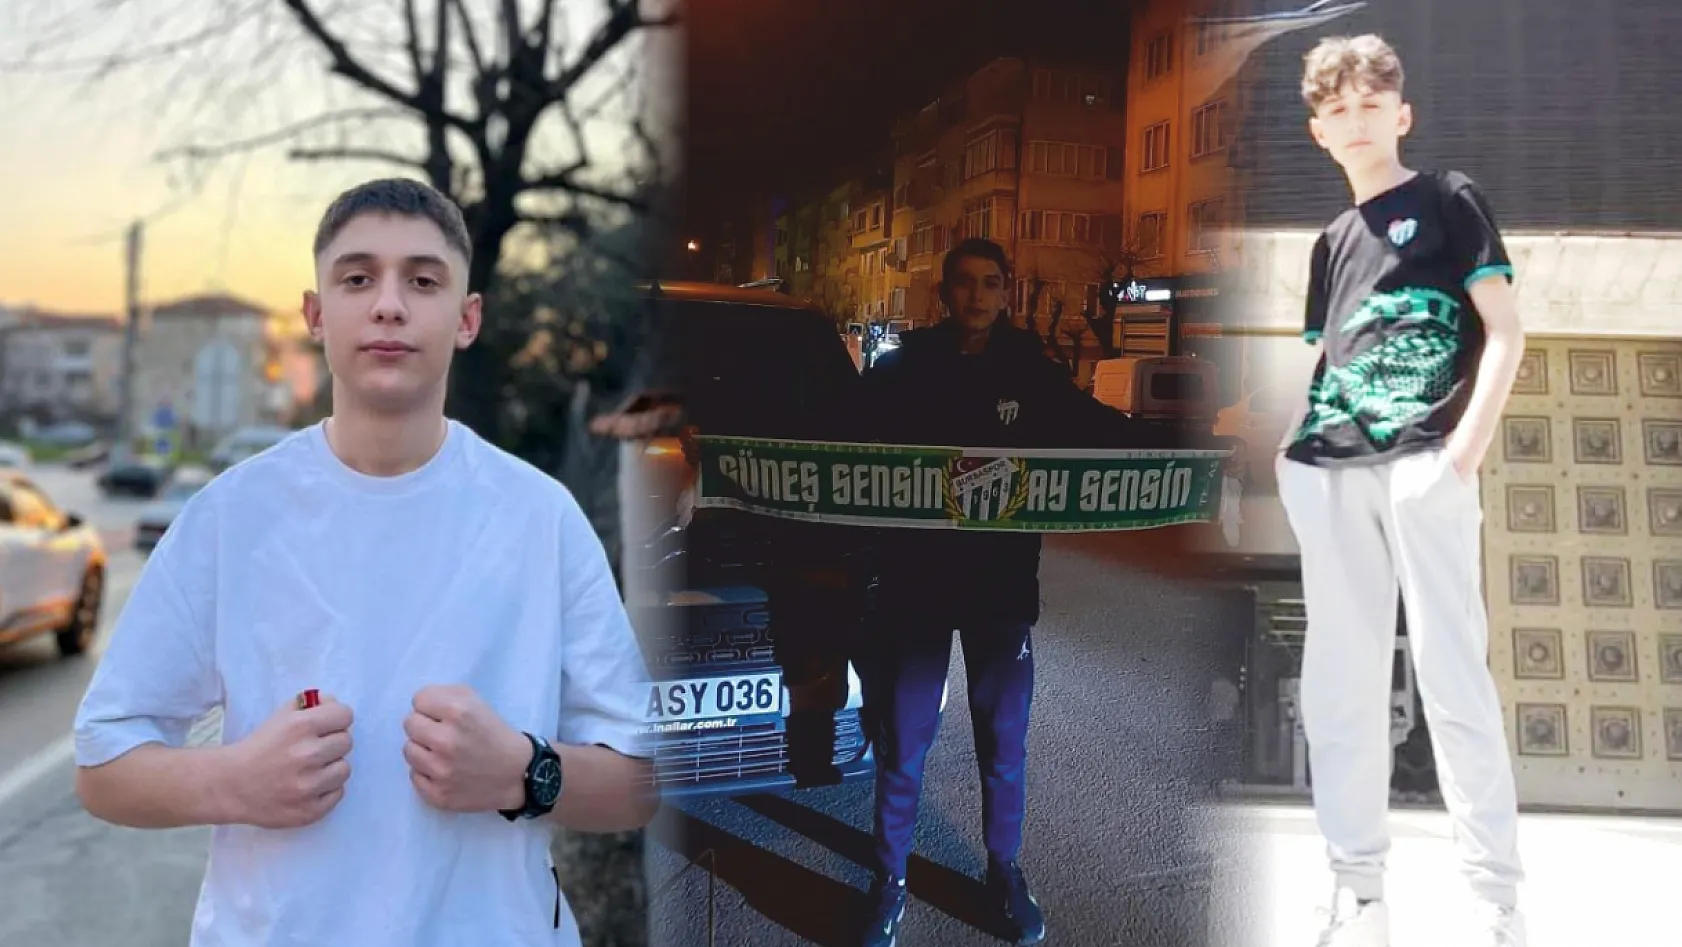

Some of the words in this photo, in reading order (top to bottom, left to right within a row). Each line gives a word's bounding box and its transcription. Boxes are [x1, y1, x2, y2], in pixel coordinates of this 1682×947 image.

[1027, 469, 1069, 512] AY
[645, 682, 708, 718] ASY
[716, 678, 773, 712] 036
